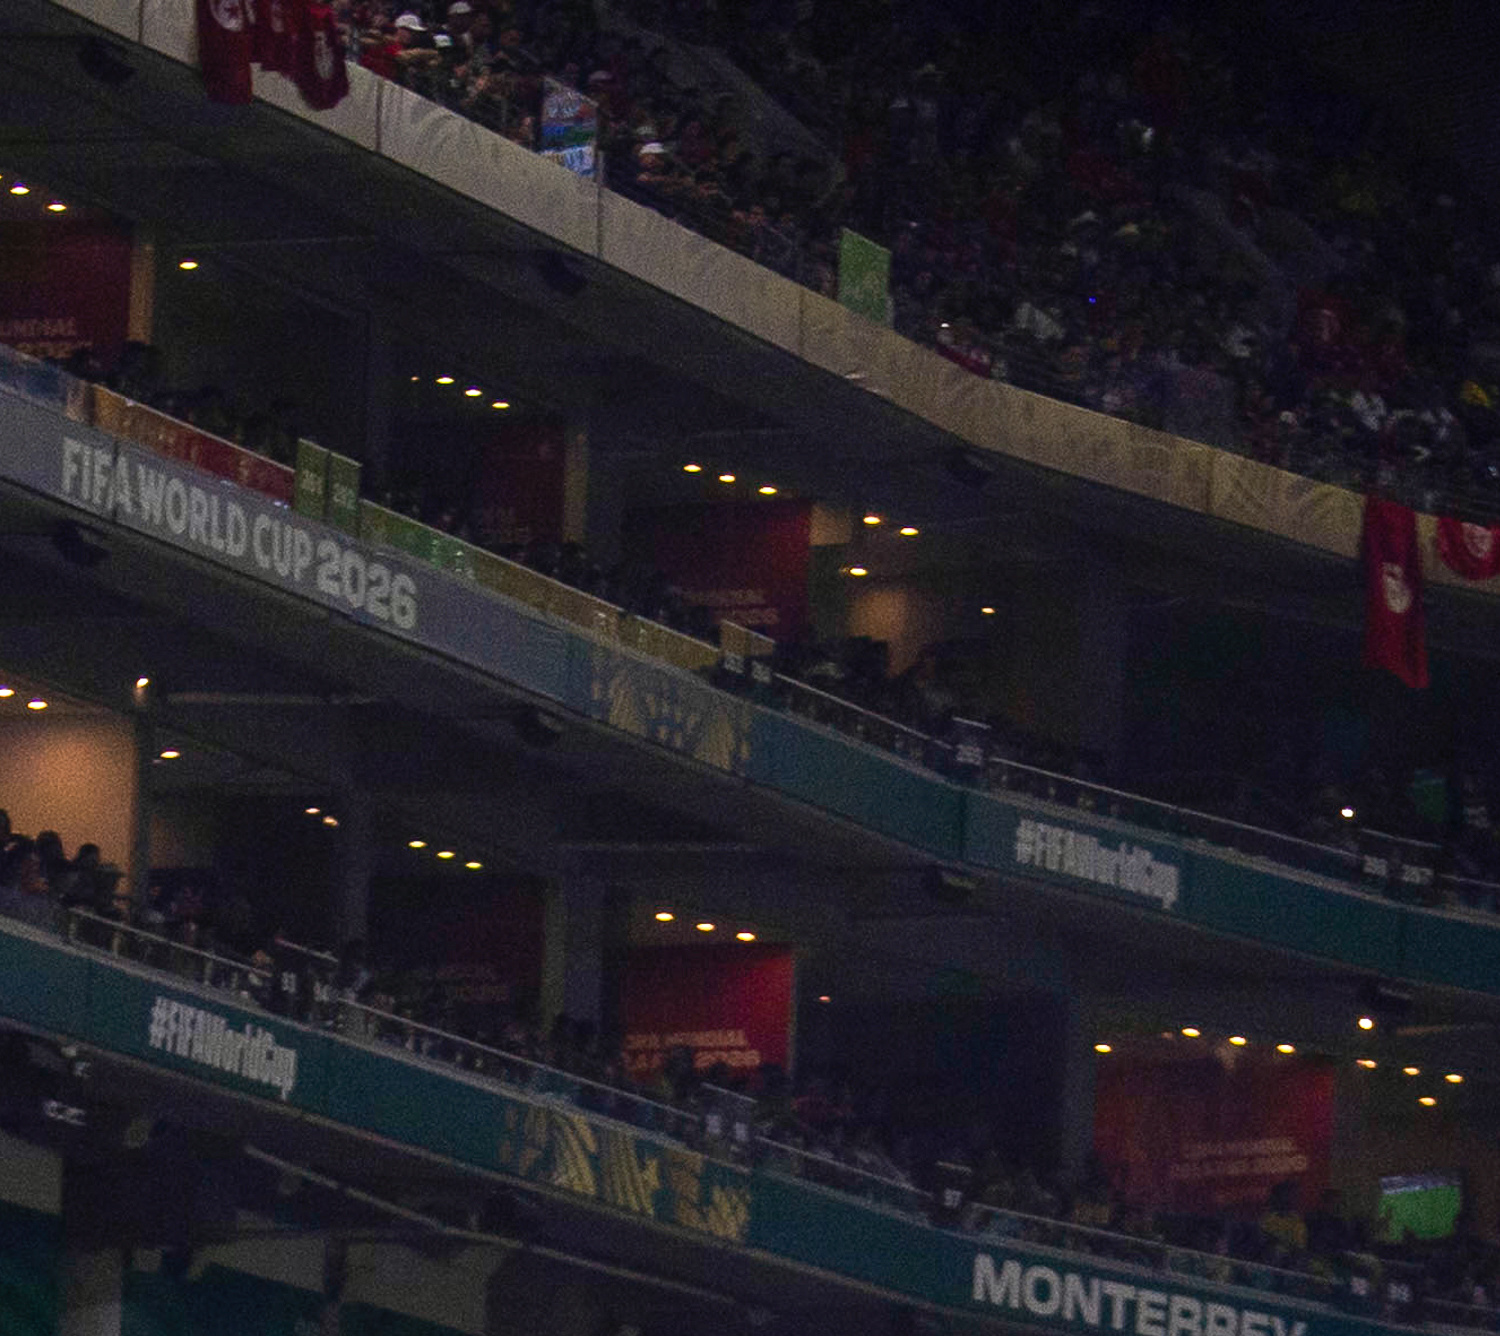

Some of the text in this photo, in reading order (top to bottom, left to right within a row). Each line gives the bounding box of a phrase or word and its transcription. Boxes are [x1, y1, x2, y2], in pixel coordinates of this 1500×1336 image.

[61, 436, 419, 631] FIFA WORLD CUP 2026
